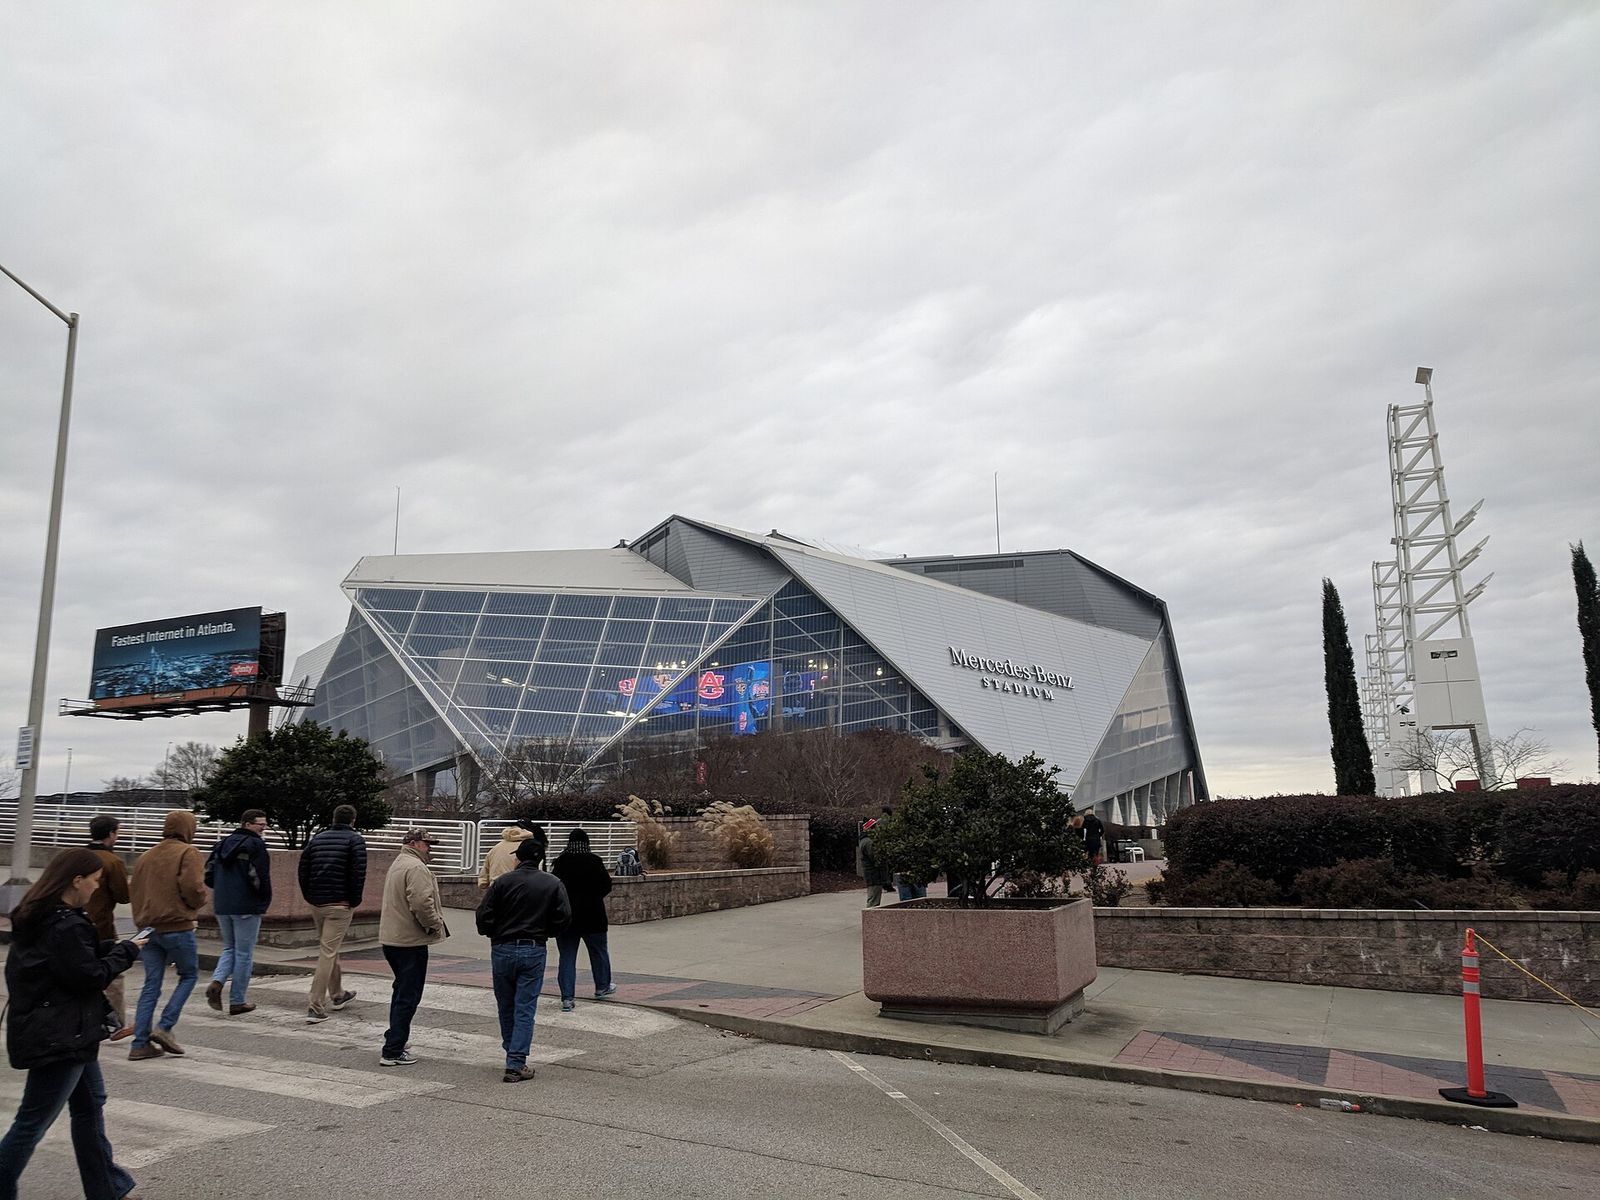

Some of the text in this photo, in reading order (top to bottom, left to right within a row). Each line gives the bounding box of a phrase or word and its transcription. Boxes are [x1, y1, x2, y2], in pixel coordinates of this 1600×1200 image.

[111, 621, 236, 647] Fastest Internet in Atlanta.
[948, 645, 1076, 690] Mercedes-Benz
[982, 675, 1056, 701] STADIUM
